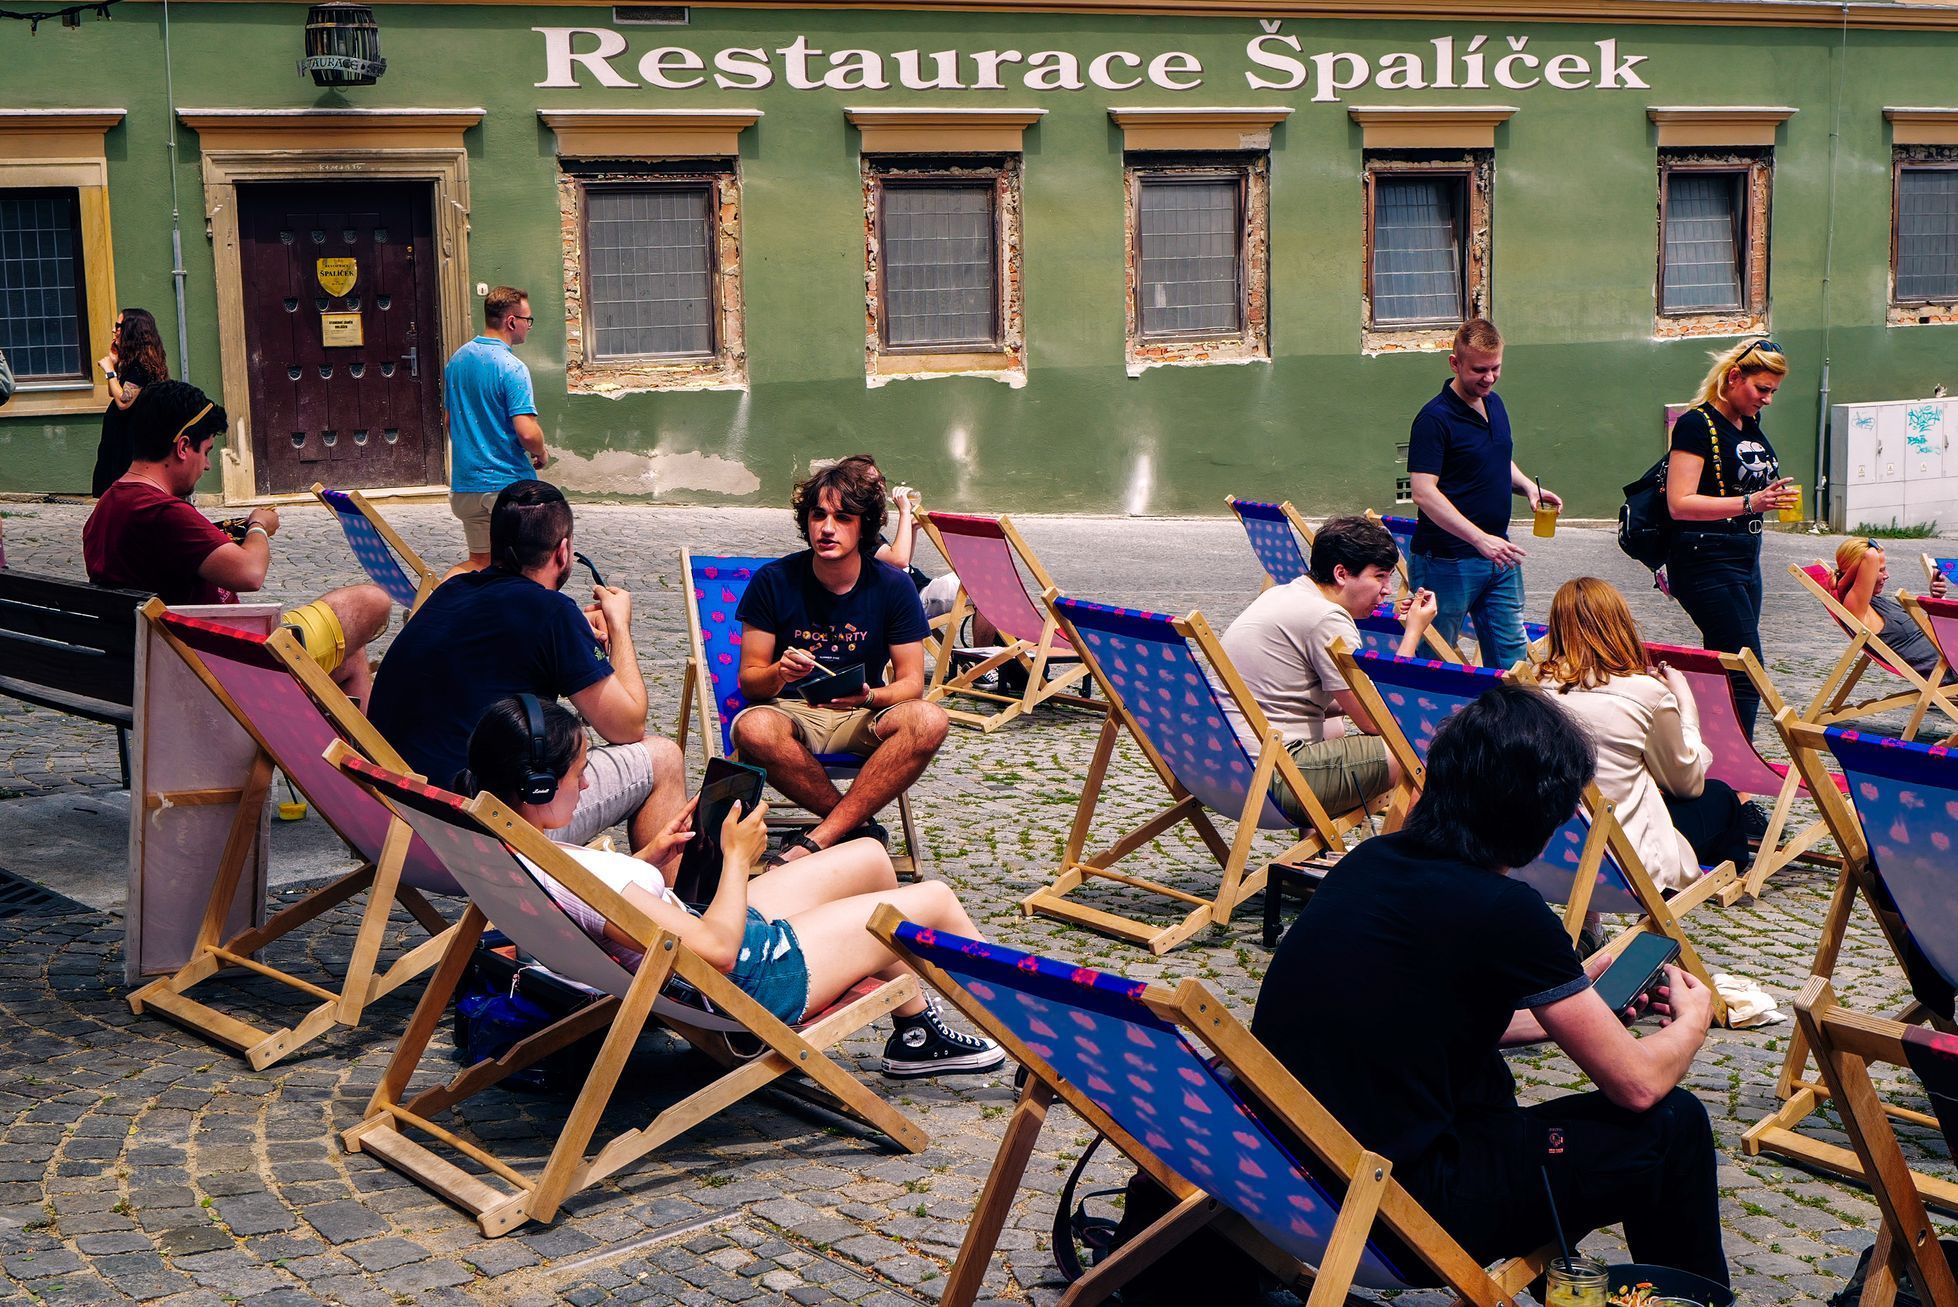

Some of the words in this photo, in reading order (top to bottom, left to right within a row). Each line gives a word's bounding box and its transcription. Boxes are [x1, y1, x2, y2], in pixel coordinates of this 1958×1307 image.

[532, 27, 1203, 90] Restaurace
[1245, 19, 1652, 103] Špalíček
[832, 630, 868, 643] ARTY
